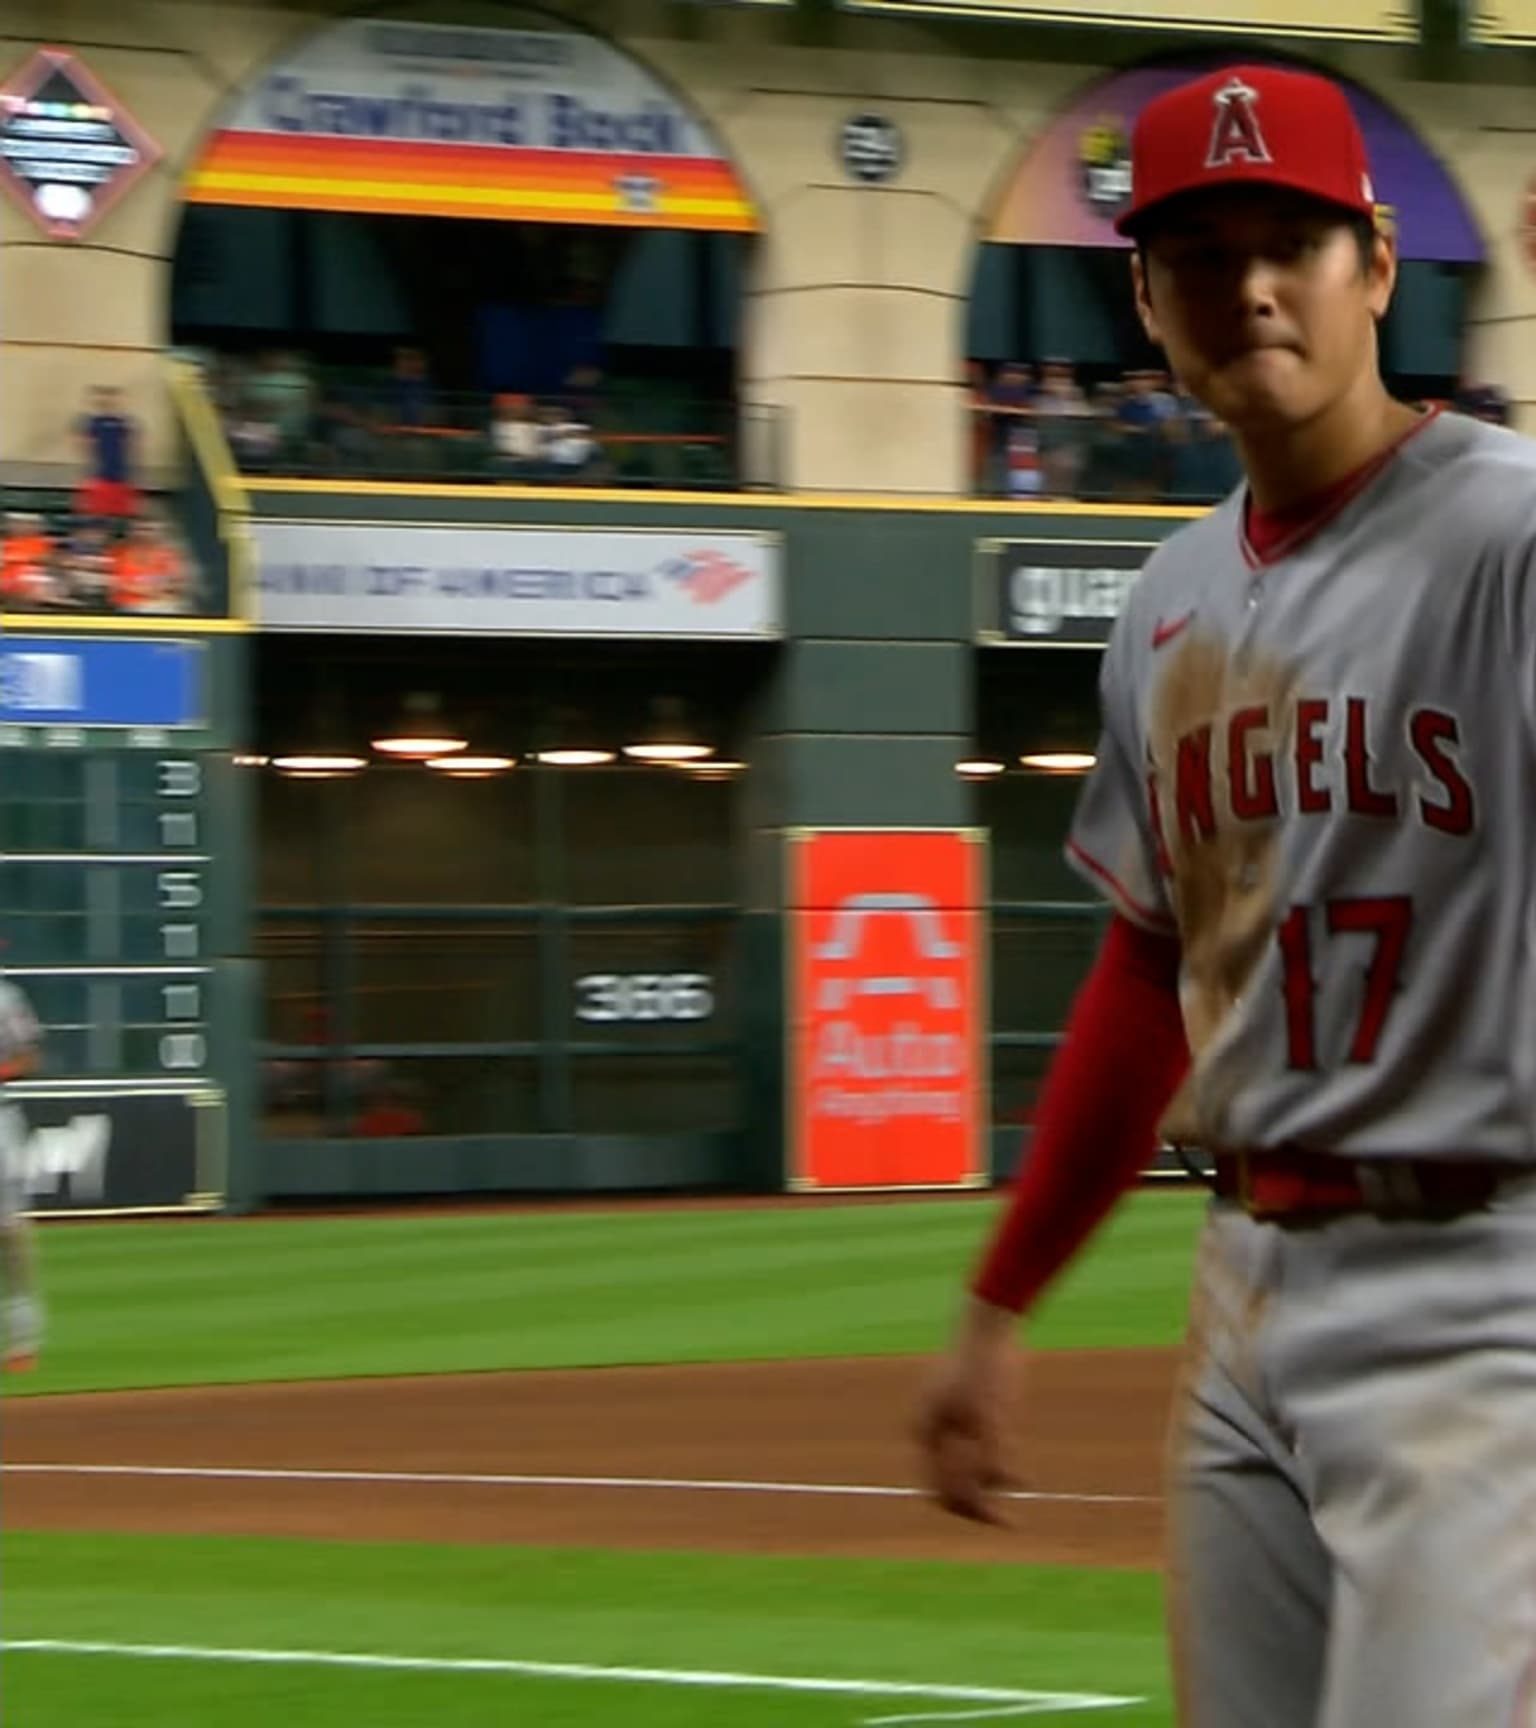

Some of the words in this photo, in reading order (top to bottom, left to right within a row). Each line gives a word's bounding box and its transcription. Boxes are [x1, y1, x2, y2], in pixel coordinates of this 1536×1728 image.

[263, 75, 520, 146] Crawford
[257, 562, 348, 596] ANK
[431, 566, 652, 602] AMERICA
[1278, 894, 1414, 1073] 17
[815, 1020, 962, 1079] Auto
